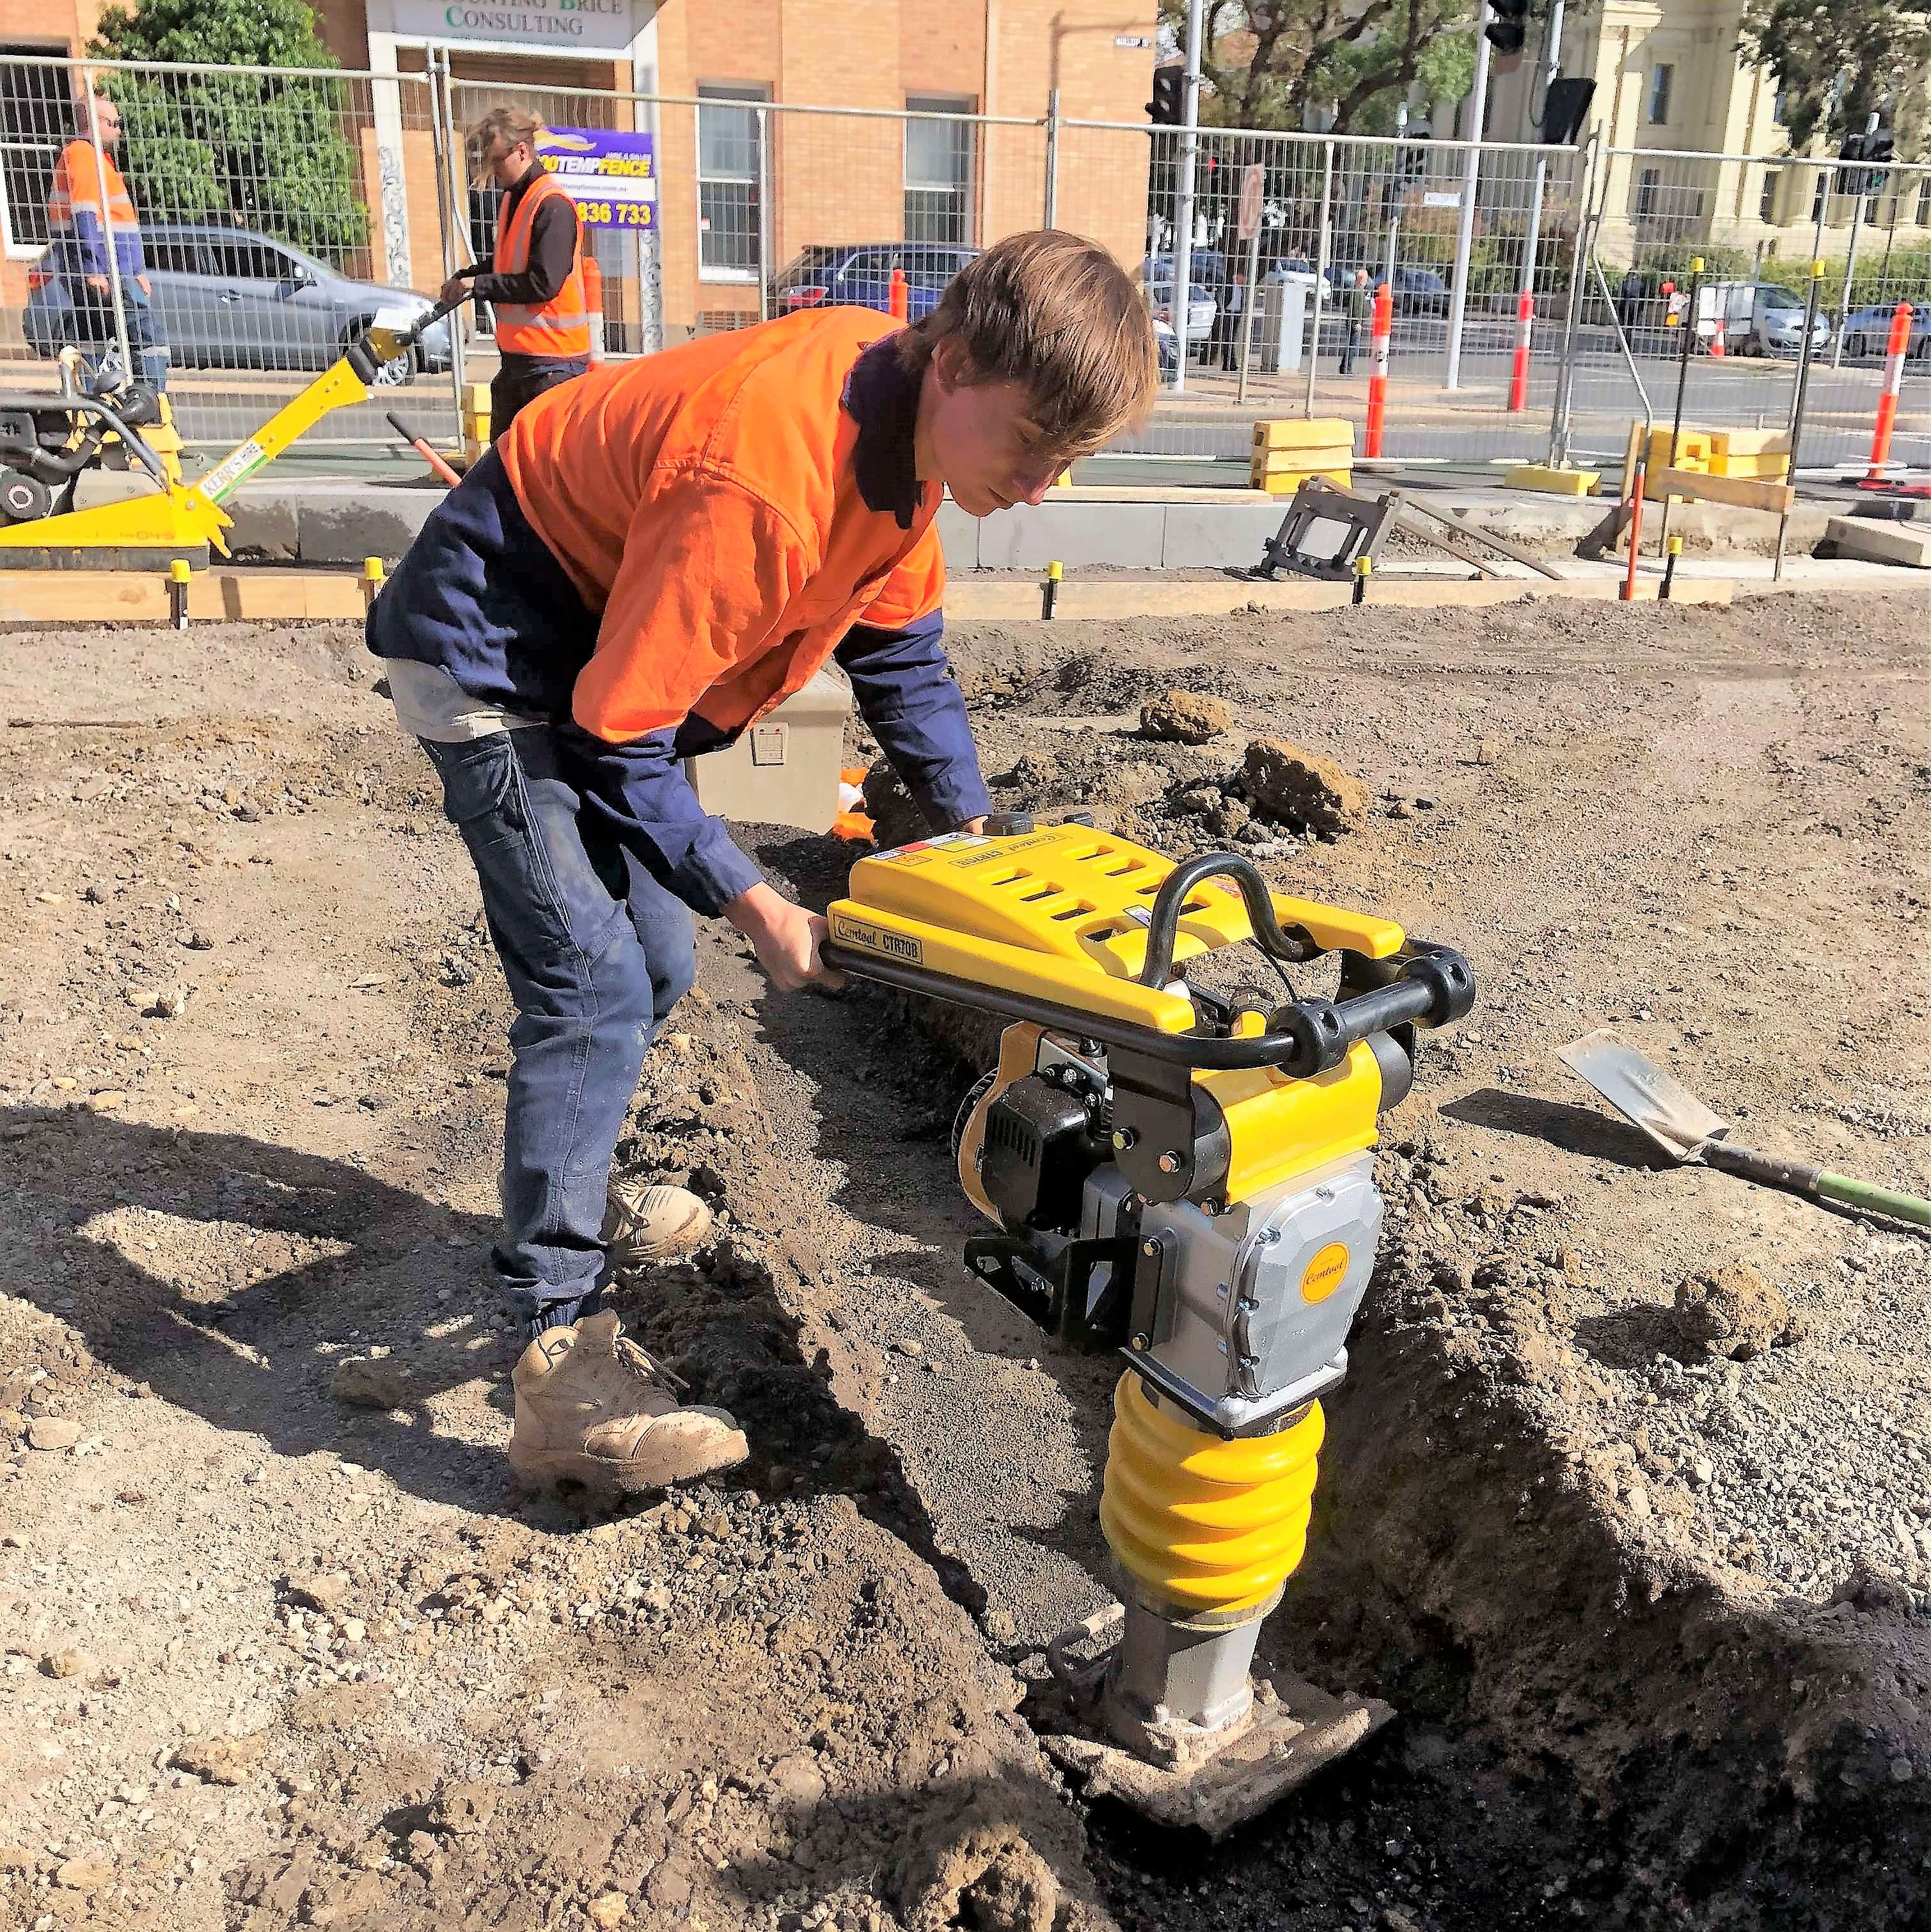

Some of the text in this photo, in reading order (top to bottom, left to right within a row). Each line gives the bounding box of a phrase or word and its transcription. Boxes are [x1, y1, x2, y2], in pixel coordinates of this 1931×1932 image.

[445, 5, 583, 35] CONSULTING
[616, 203, 652, 225] 733
[883, 933, 918, 958] CTR70B
